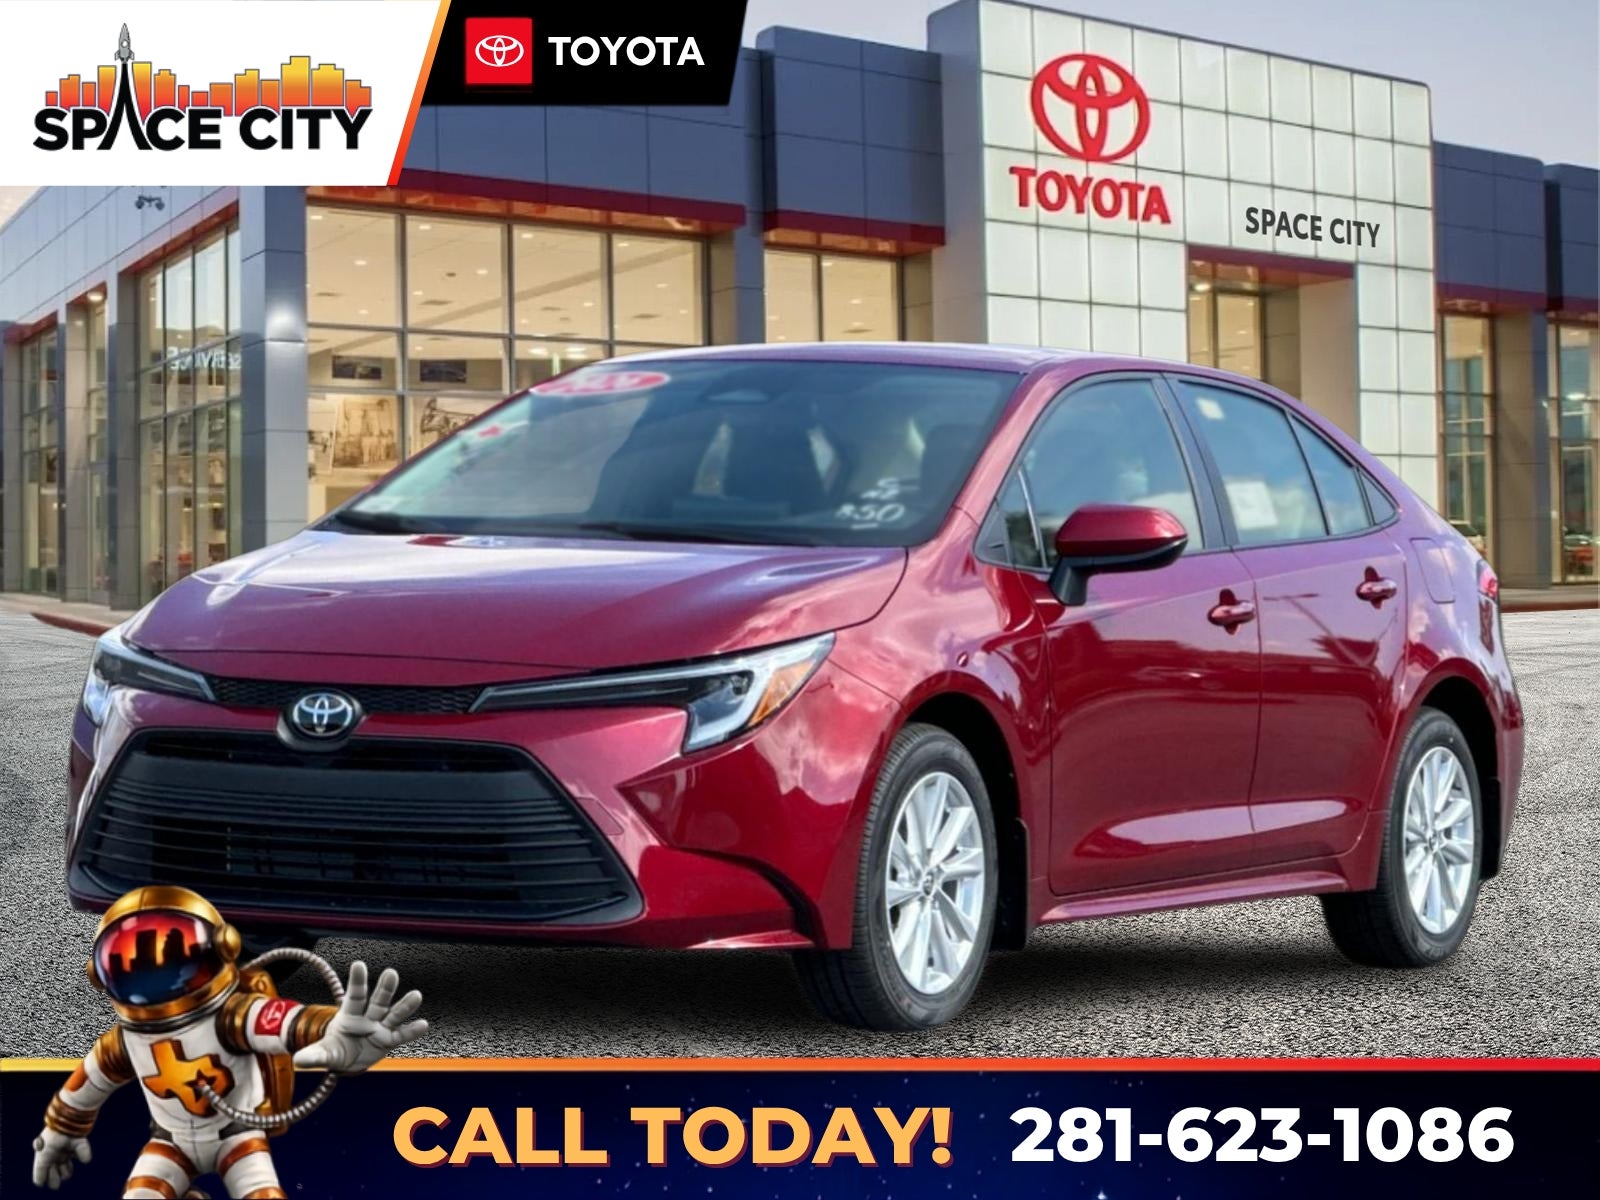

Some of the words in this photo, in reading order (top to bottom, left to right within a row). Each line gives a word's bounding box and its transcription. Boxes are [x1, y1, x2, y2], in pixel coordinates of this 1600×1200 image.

[1009, 166, 1171, 224] TOYOTA
[1245, 206, 1322, 242] SPACE
[1329, 218, 1380, 248] CITY
